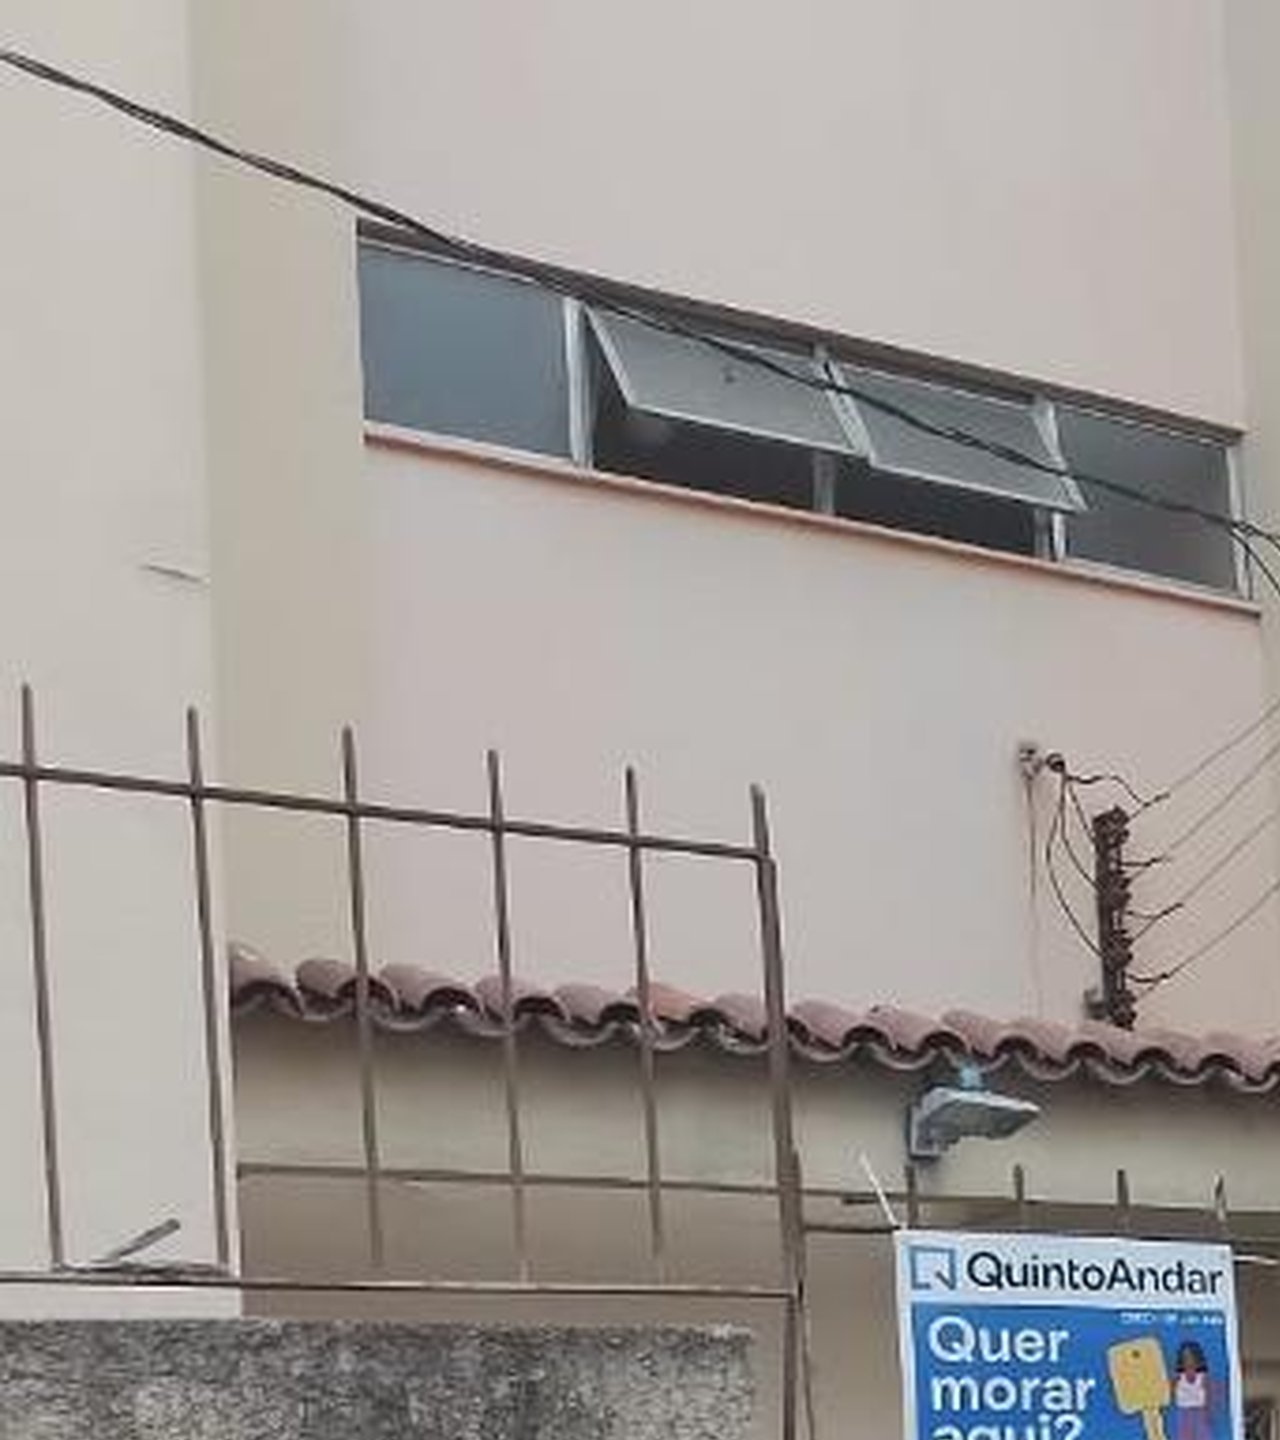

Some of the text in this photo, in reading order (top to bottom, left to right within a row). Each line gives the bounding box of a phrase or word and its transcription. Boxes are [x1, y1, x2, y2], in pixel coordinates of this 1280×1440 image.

[966, 1251, 1223, 1294] QuintoAndar
[929, 1315, 1069, 1362] Quer
[931, 1376, 1095, 1411] morar
